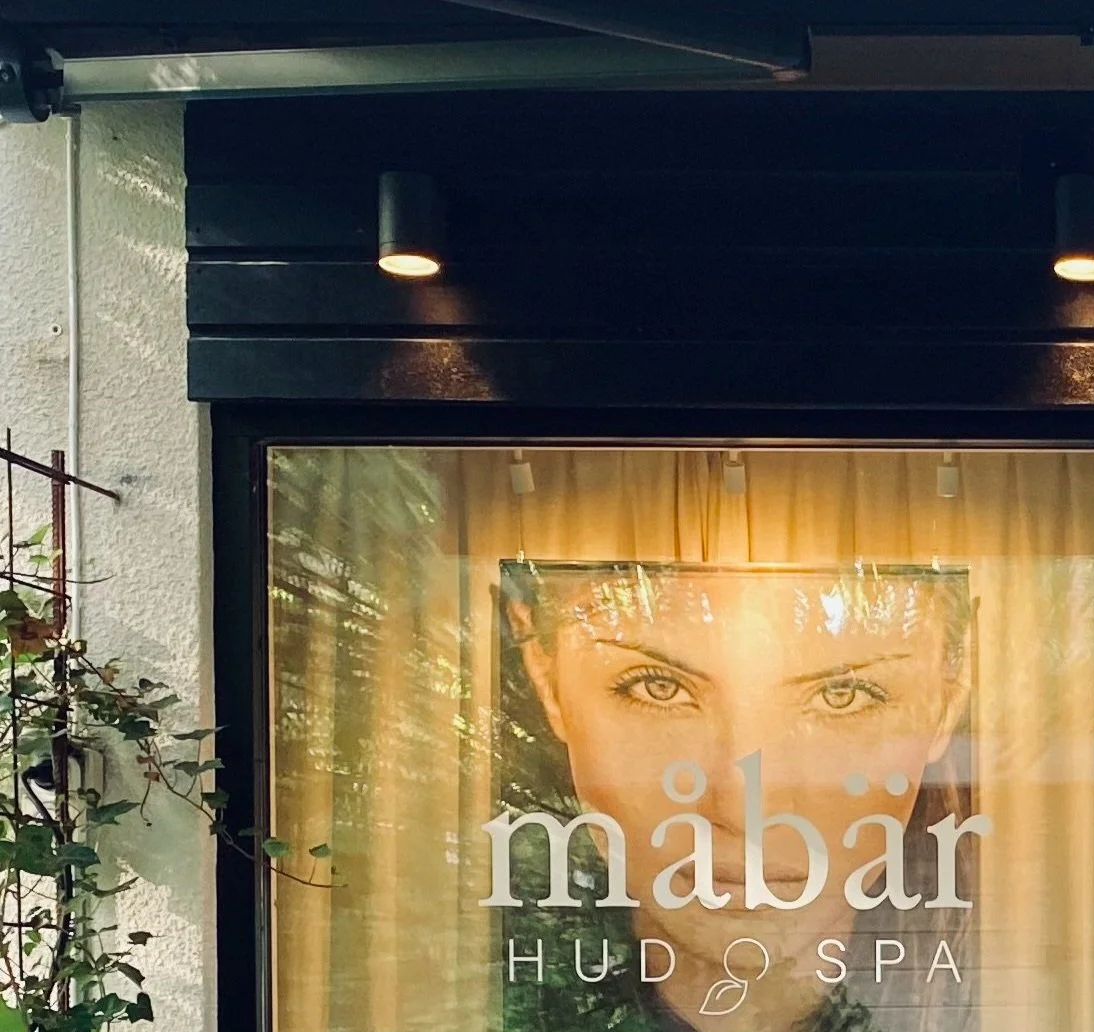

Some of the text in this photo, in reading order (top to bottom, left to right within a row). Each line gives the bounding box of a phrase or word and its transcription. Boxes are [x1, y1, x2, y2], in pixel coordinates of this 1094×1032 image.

[478, 748, 991, 910] måbär
[508, 938, 962, 984] HUD SPA
